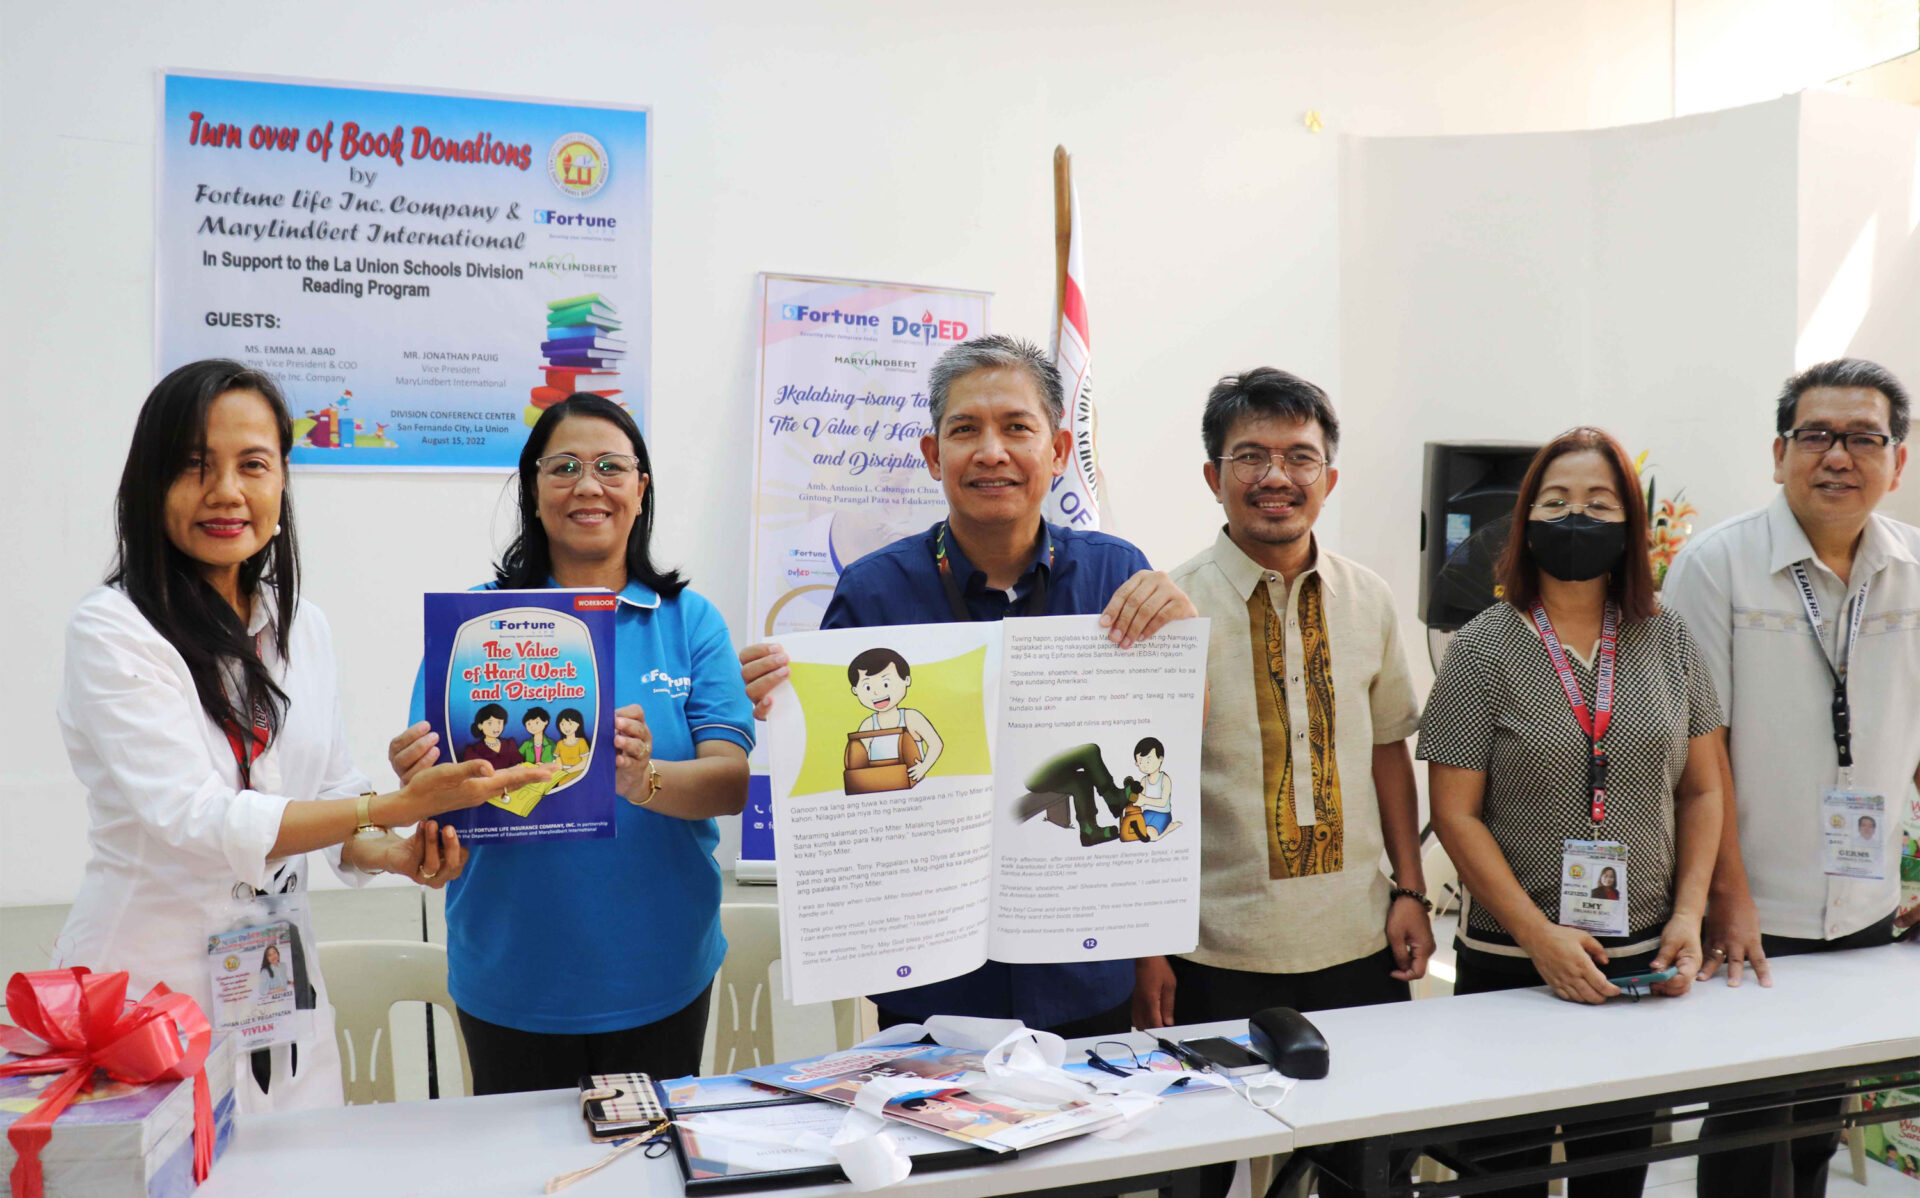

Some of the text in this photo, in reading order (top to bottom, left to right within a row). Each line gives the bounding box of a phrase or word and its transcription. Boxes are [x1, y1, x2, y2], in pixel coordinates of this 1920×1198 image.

[189, 111, 242, 148] Turn
[249, 124, 300, 151] over
[306, 120, 333, 162] of
[340, 121, 404, 167] Book
[411, 126, 533, 171] Donations
[350, 166, 376, 187] by
[195, 183, 520, 222] Fortune Life Inc. Company &
[546, 210, 617, 228] Fortune
[198, 215, 527, 249] MaryLindbert International
[203, 250, 524, 281] In Support to the La Union Schools Division
[529, 261, 618, 273] MARYLINDBERT
[302, 277, 430, 300] Reading Program
[205, 312, 281, 328] GUESTS:
[797, 305, 880, 327] Fortune
[892, 311, 968, 344] DepED
[245, 345, 336, 355] MS. EMMA M. ABAD
[403, 351, 499, 361] MR. JONATHAN PAUIG
[266, 360, 283, 368] Vice
[286, 360, 326, 369] President
[329, 361, 335, 369] &
[422, 365, 480, 374] Vice President
[835, 356, 917, 369] MARYLINDBERT
[288, 373, 301, 381] Inc.
[306, 374, 346, 383] Company
[395, 377, 507, 387] MaryLindbert International
[390, 410, 516, 420] DIVISION CONFERENCE CENTER
[397, 423, 412, 431] San
[415, 423, 452, 432] Fernando
[455, 424, 472, 433] City,
[485, 425, 509, 433] Union
[769, 415, 799, 435] The
[803, 416, 859, 438] Value
[863, 420, 880, 442] of
[422, 436, 486, 446] August 15, 2022
[813, 450, 928, 475] and Discipline
[806, 483, 828, 491] Amb.
[830, 484, 862, 493] Antonio
[917, 486, 939, 494] Chua
[799, 494, 832, 504] Gintong
[834, 495, 869, 505] Parangal
[871, 496, 890, 504] Para
[902, 497, 946, 506] Edukasyon
[578, 599, 615, 607] WORKBOOK
[499, 620, 556, 630] Fortune
[483, 640, 559, 658] The Value
[1533, 606, 1585, 707] UNION SCHOOLS DIVISION
[463, 661, 576, 683] of Hard Work
[1597, 638, 1616, 713] DEPARTMENT OF
[470, 681, 585, 702] and Discipline
[1086, 940, 1095, 948] 12
[899, 966, 908, 975] 11
[242, 1023, 274, 1037] VIVIAN
